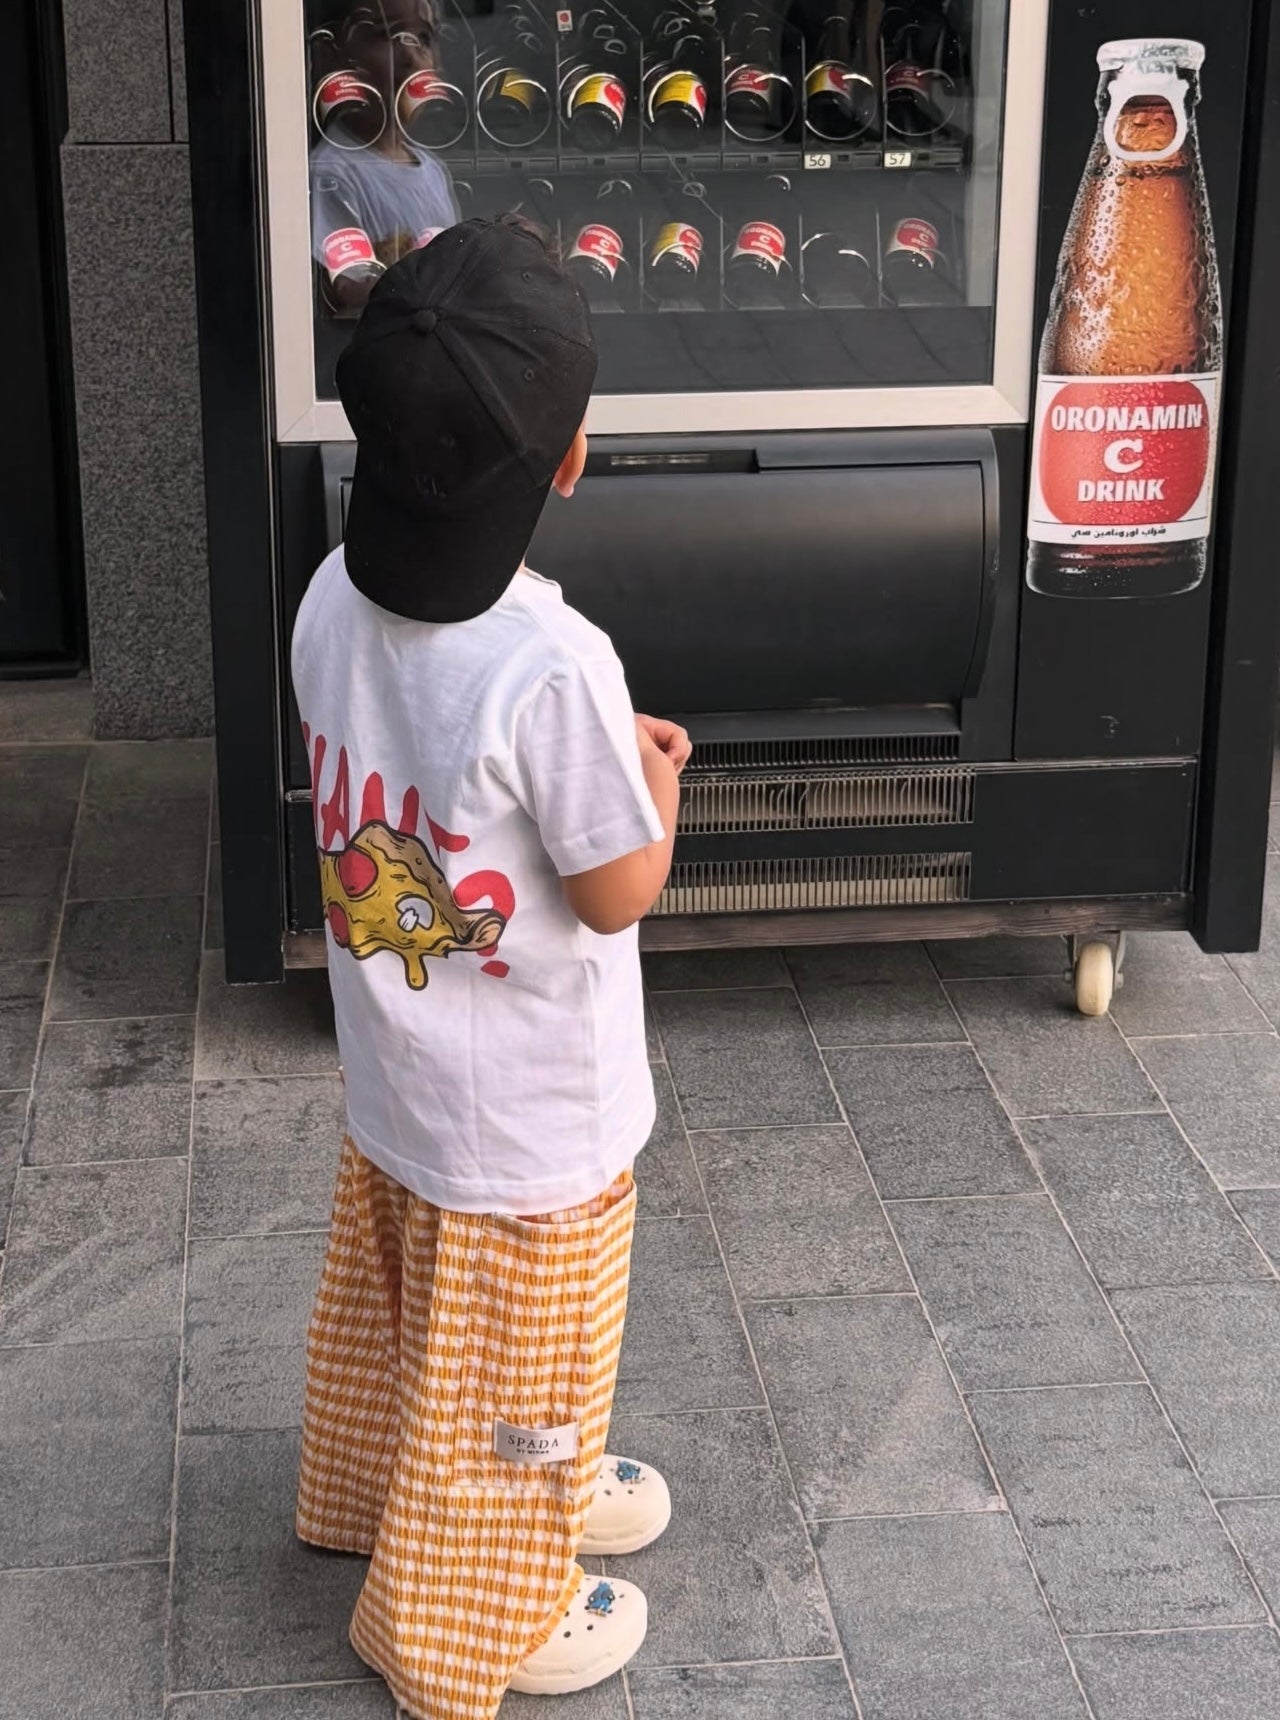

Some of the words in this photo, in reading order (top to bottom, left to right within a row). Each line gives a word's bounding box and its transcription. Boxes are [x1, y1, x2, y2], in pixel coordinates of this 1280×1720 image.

[809, 154, 826, 167] 56
[889, 154, 906, 166] 57
[1051, 404, 1203, 433] ORONAMIN
[1103, 438, 1144, 474] C
[1077, 478, 1165, 503] DRINK
[507, 1434, 559, 1449] SPADA
